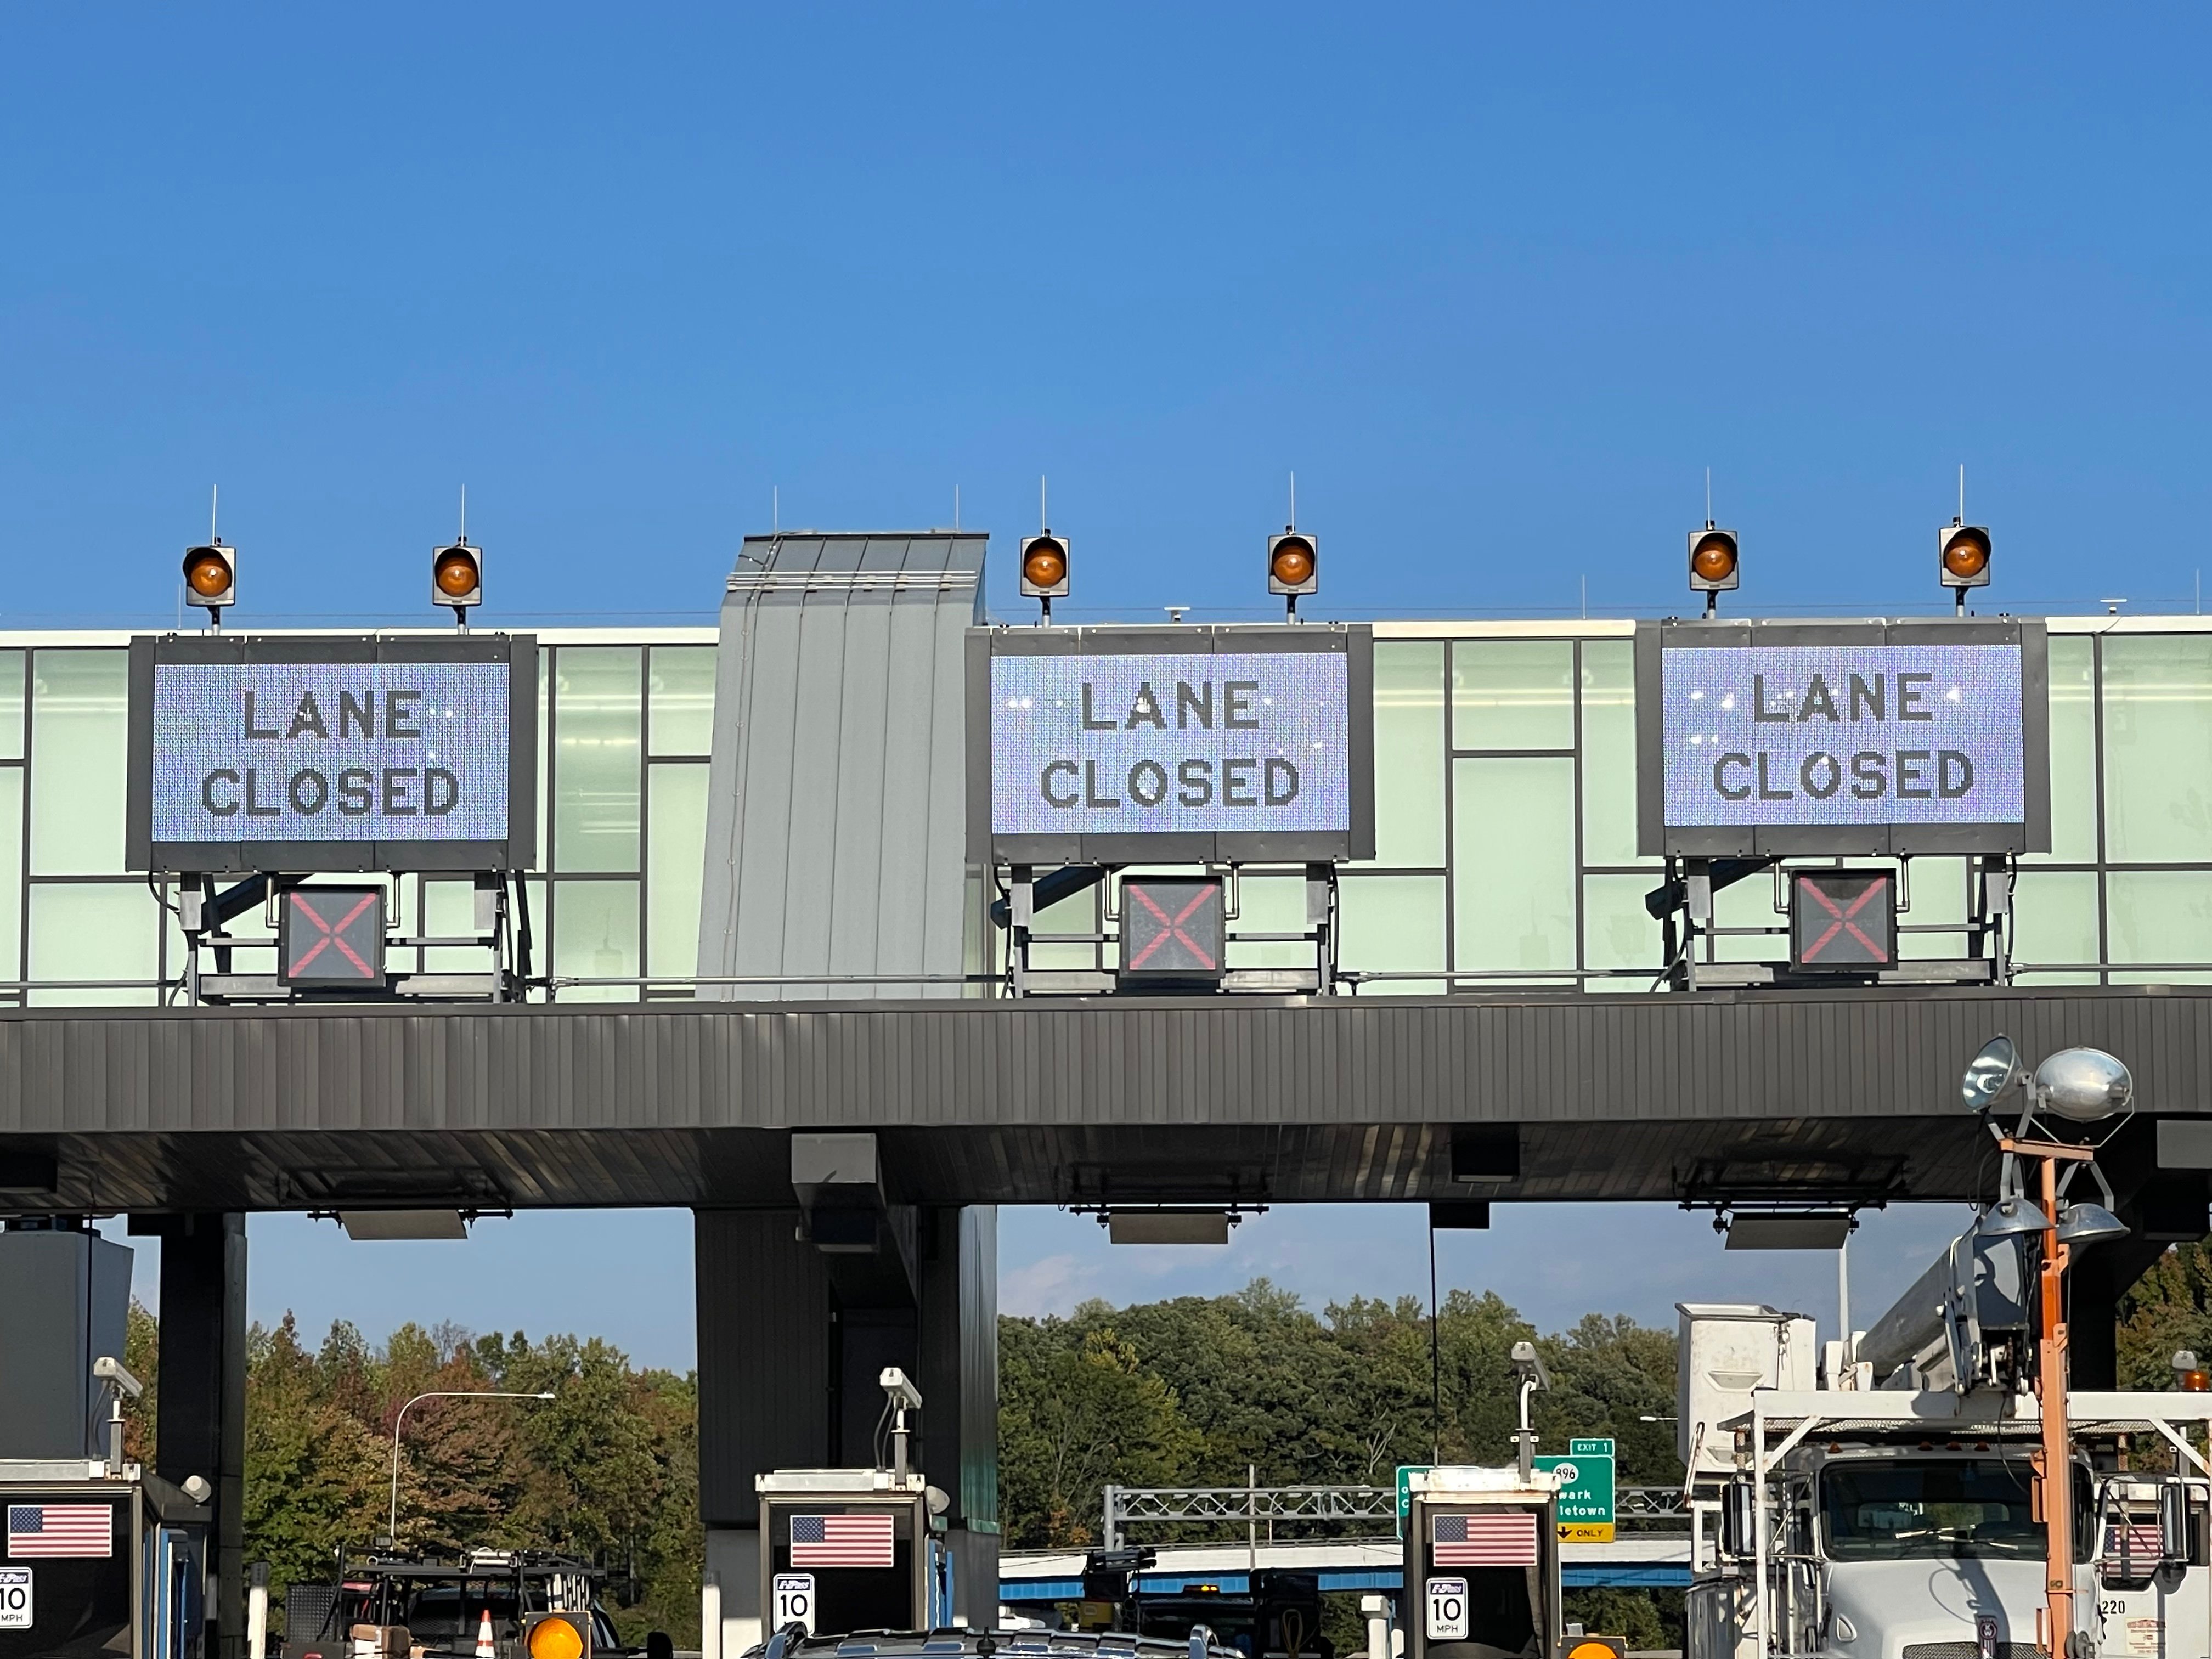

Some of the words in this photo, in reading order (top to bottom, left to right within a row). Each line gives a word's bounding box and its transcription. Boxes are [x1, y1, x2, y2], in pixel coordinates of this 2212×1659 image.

[244, 690, 421, 739] LANE
[1082, 681, 1260, 730] LANE
[1754, 673, 1933, 723] LANE
[201, 768, 459, 816] CLOSED
[1042, 758, 1300, 809] CLOSED
[1713, 750, 1974, 800] CLOSED
[1603, 1442, 1608, 1452] 1
[0, 1587, 26, 1610] 10
[780, 1594, 808, 1617] 10
[1433, 1598, 1461, 1621] 10
[2101, 1600, 2125, 1614] 220
[1436, 1624, 1458, 1633] MPH
